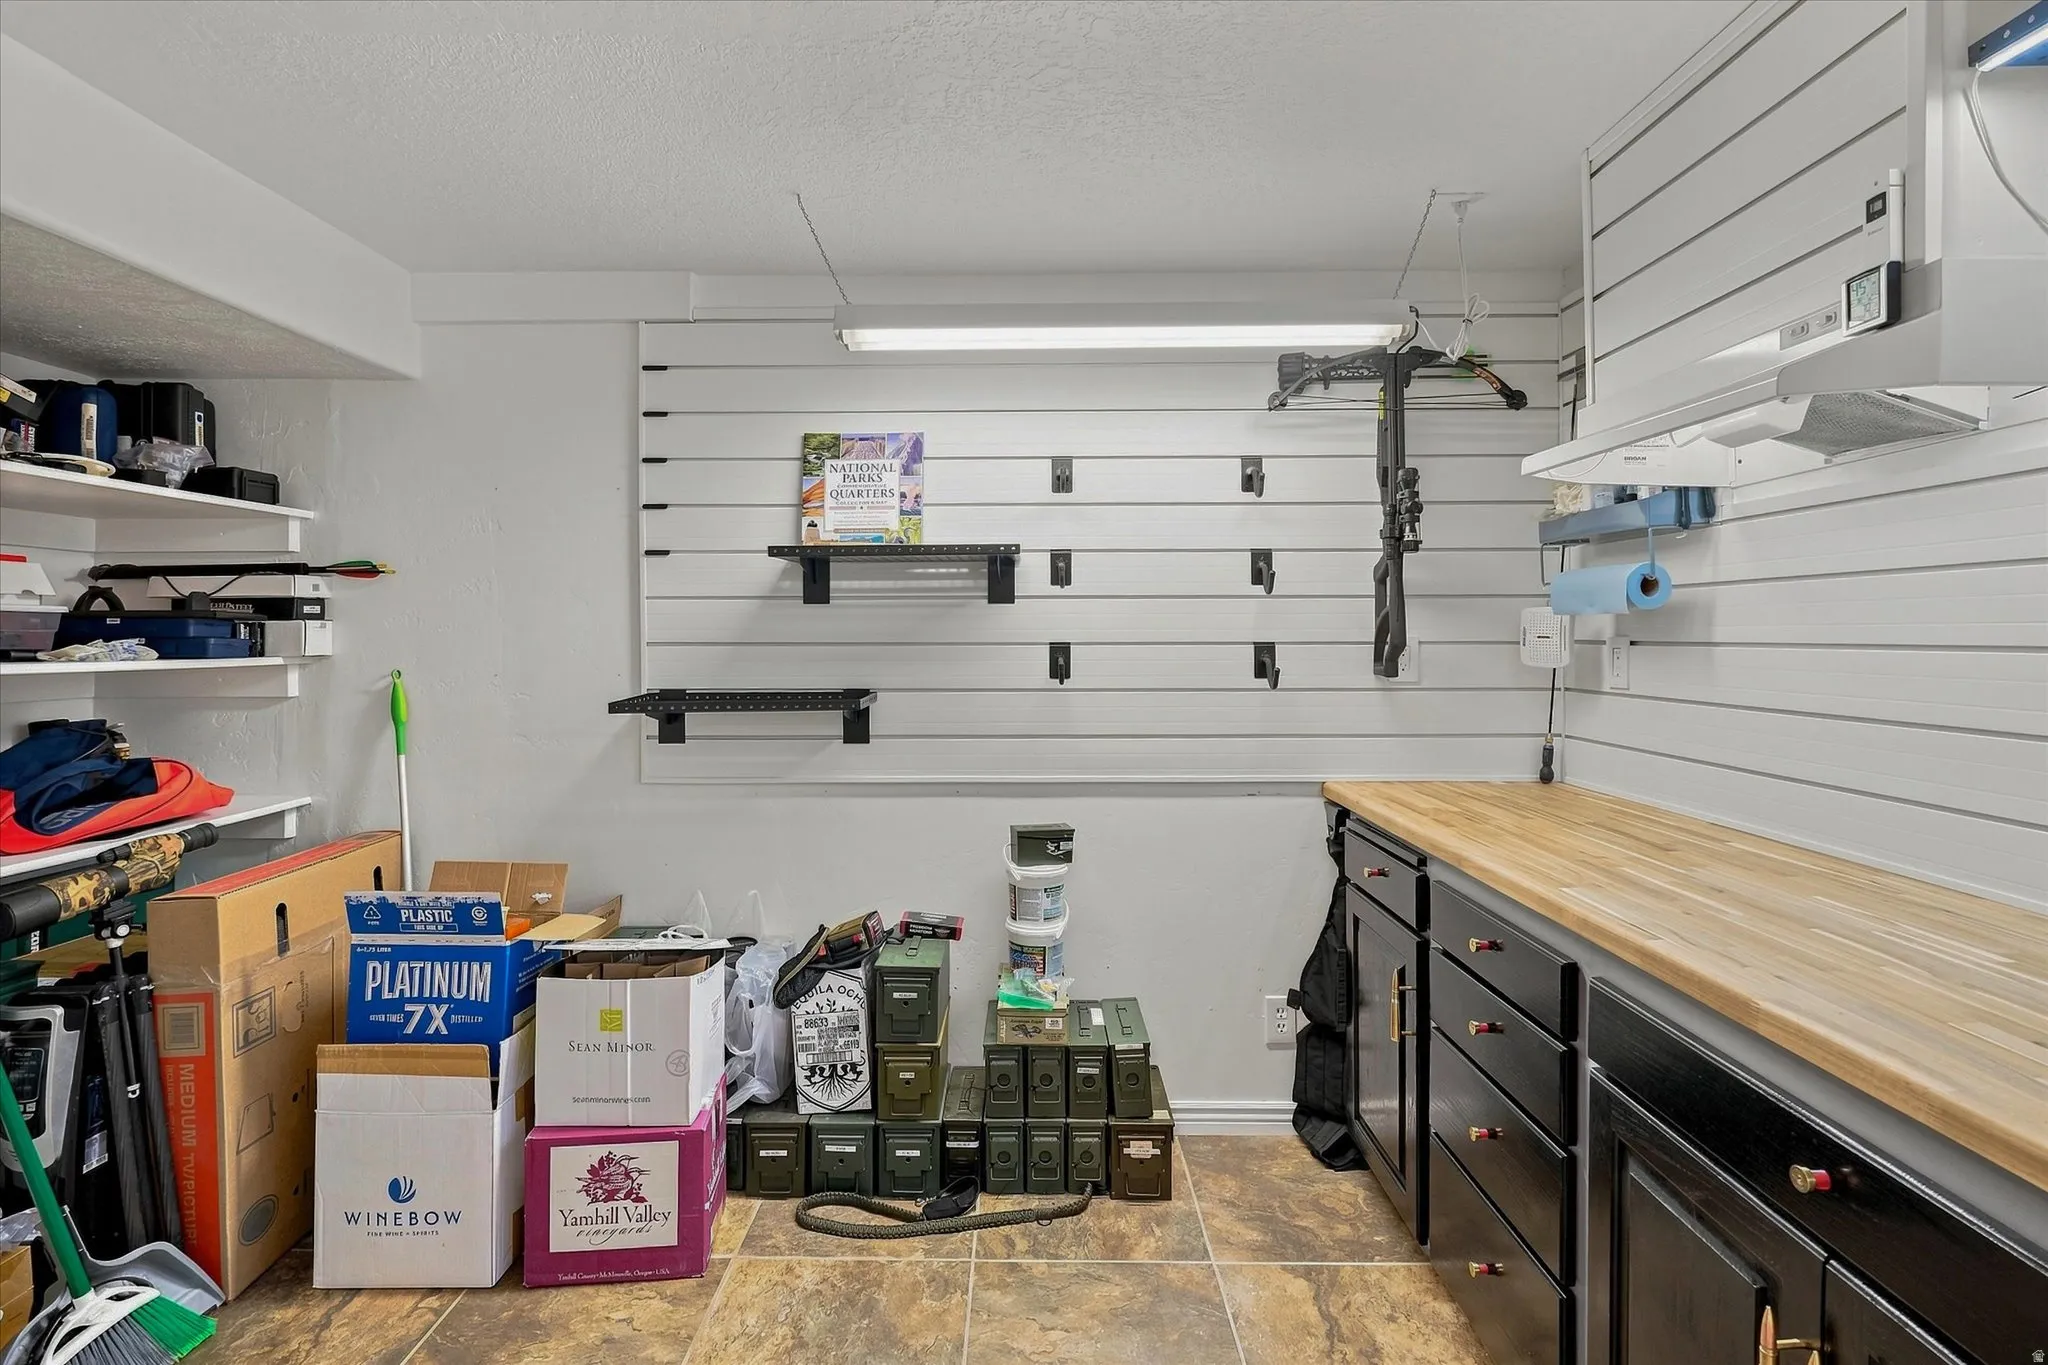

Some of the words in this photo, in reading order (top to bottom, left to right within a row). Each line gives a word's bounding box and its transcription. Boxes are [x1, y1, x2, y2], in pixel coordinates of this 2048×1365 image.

[829, 463, 896, 473] NATIONAL
[842, 473, 883, 483] PARKS
[830, 488, 895, 500] QUARTERS
[400, 909, 453, 922] PLASTIC
[365, 961, 492, 1002] PLATINUM
[386, 1014, 404, 1022] TIMES
[450, 1015, 483, 1023] DISTILLED
[403, 1004, 450, 1034] 7X
[568, 1040, 601, 1052] SEAN
[607, 1042, 654, 1053] MINOR
[180, 1064, 196, 1146] MEDIUM
[344, 1210, 462, 1226] WINEBOW
[558, 1206, 619, 1227] Yamhill
[623, 1204, 672, 1228] Valley
[576, 1222, 652, 1246] vineyards
